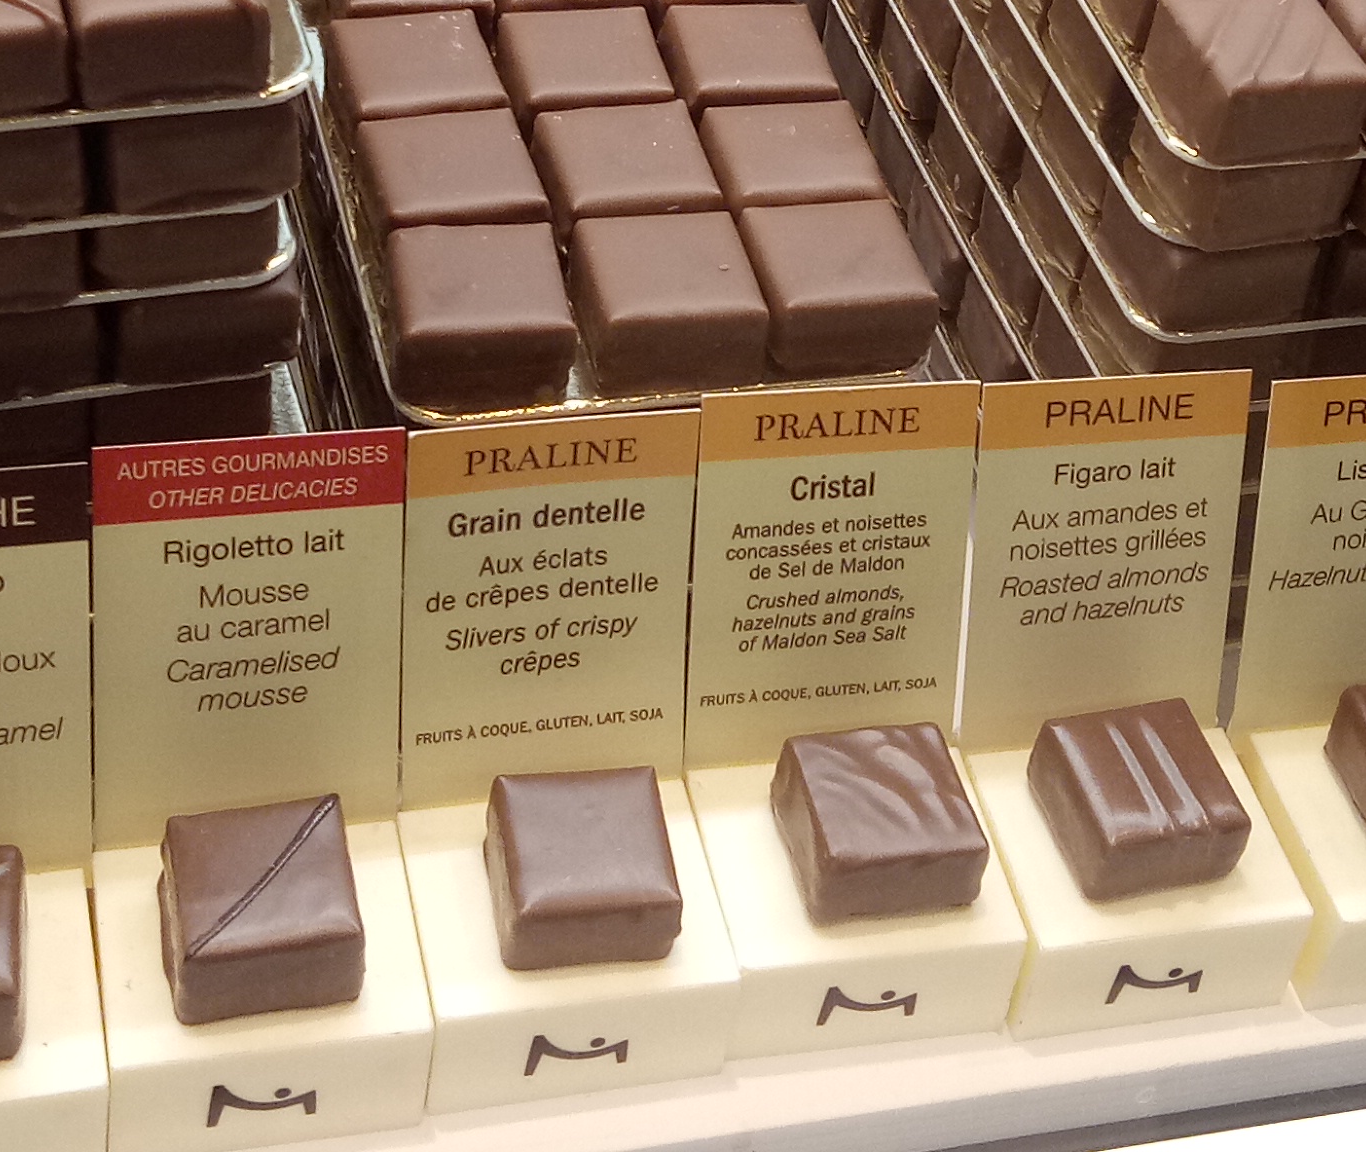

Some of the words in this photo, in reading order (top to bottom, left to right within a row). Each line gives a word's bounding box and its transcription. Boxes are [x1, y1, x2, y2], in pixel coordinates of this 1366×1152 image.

[753, 406, 921, 442] PRALINE
[1045, 393, 1195, 428] PRALINE
[117, 457, 206, 481] AUTRES
[212, 445, 389, 474] GOURMANDISES
[464, 438, 639, 477] PRALINE
[1054, 463, 1132, 489] Figaro
[1140, 457, 1177, 480] lait
[148, 488, 223, 510] OTHER
[230, 477, 359, 503] DELICACIES
[790, 471, 876, 501] Cristal
[448, 508, 521, 538] Grain
[533, 498, 645, 528] dentelle
[731, 520, 815, 540] Amandes
[821, 517, 840, 533] et
[845, 514, 928, 532] noisettes
[1012, 509, 1060, 532] Aux
[1067, 500, 1177, 527] amandes
[1185, 497, 1209, 518] et
[1310, 503, 1343, 525] Au
[163, 534, 293, 568] Rigoletto
[304, 529, 345, 554] lait
[725, 539, 833, 561] concassées
[839, 537, 857, 553] et
[862, 533, 931, 551] cristaux
[1009, 535, 1117, 562] noisettes
[1125, 527, 1207, 556] grillées
[479, 555, 523, 577] Aux
[533, 547, 609, 572] éclats
[749, 564, 771, 581] de
[778, 560, 805, 578] Sel
[813, 559, 834, 576] de
[840, 555, 905, 574] Maldon
[199, 583, 309, 609] Mousse
[426, 591, 456, 613] de
[465, 581, 550, 609] crêpes
[559, 572, 659, 599] dentelle
[999, 570, 1103, 598] Roasted
[1107, 561, 1210, 589] almonds
[746, 589, 820, 611] Crushed
[825, 584, 905, 605] almonds,
[1020, 601, 1067, 626] and
[1072, 593, 1185, 621] hazelnuts
[177, 624, 210, 643] au
[221, 608, 331, 639] caramel
[445, 624, 526, 650] Slivers
[535, 617, 561, 641] of
[566, 615, 639, 639] crispy
[732, 610, 816, 633] hazelnuts
[822, 607, 855, 626] and
[861, 605, 915, 626] grains
[738, 635, 759, 652] of
[762, 629, 827, 651] Maldon
[833, 628, 867, 645] Sea
[872, 624, 907, 641] Salt
[167, 646, 341, 684] Caramelised
[500, 650, 580, 676] crêpes
[198, 684, 309, 712] mousse
[700, 692, 745, 708] FRUITS
[748, 689, 759, 703] À
[815, 682, 870, 698] GLUTEN,
[905, 676, 937, 690] SOJA
[415, 728, 463, 746] FRUITS
[467, 724, 477, 739] À
[535, 714, 593, 732] GLUTEN,
[629, 707, 663, 722] SOJA
